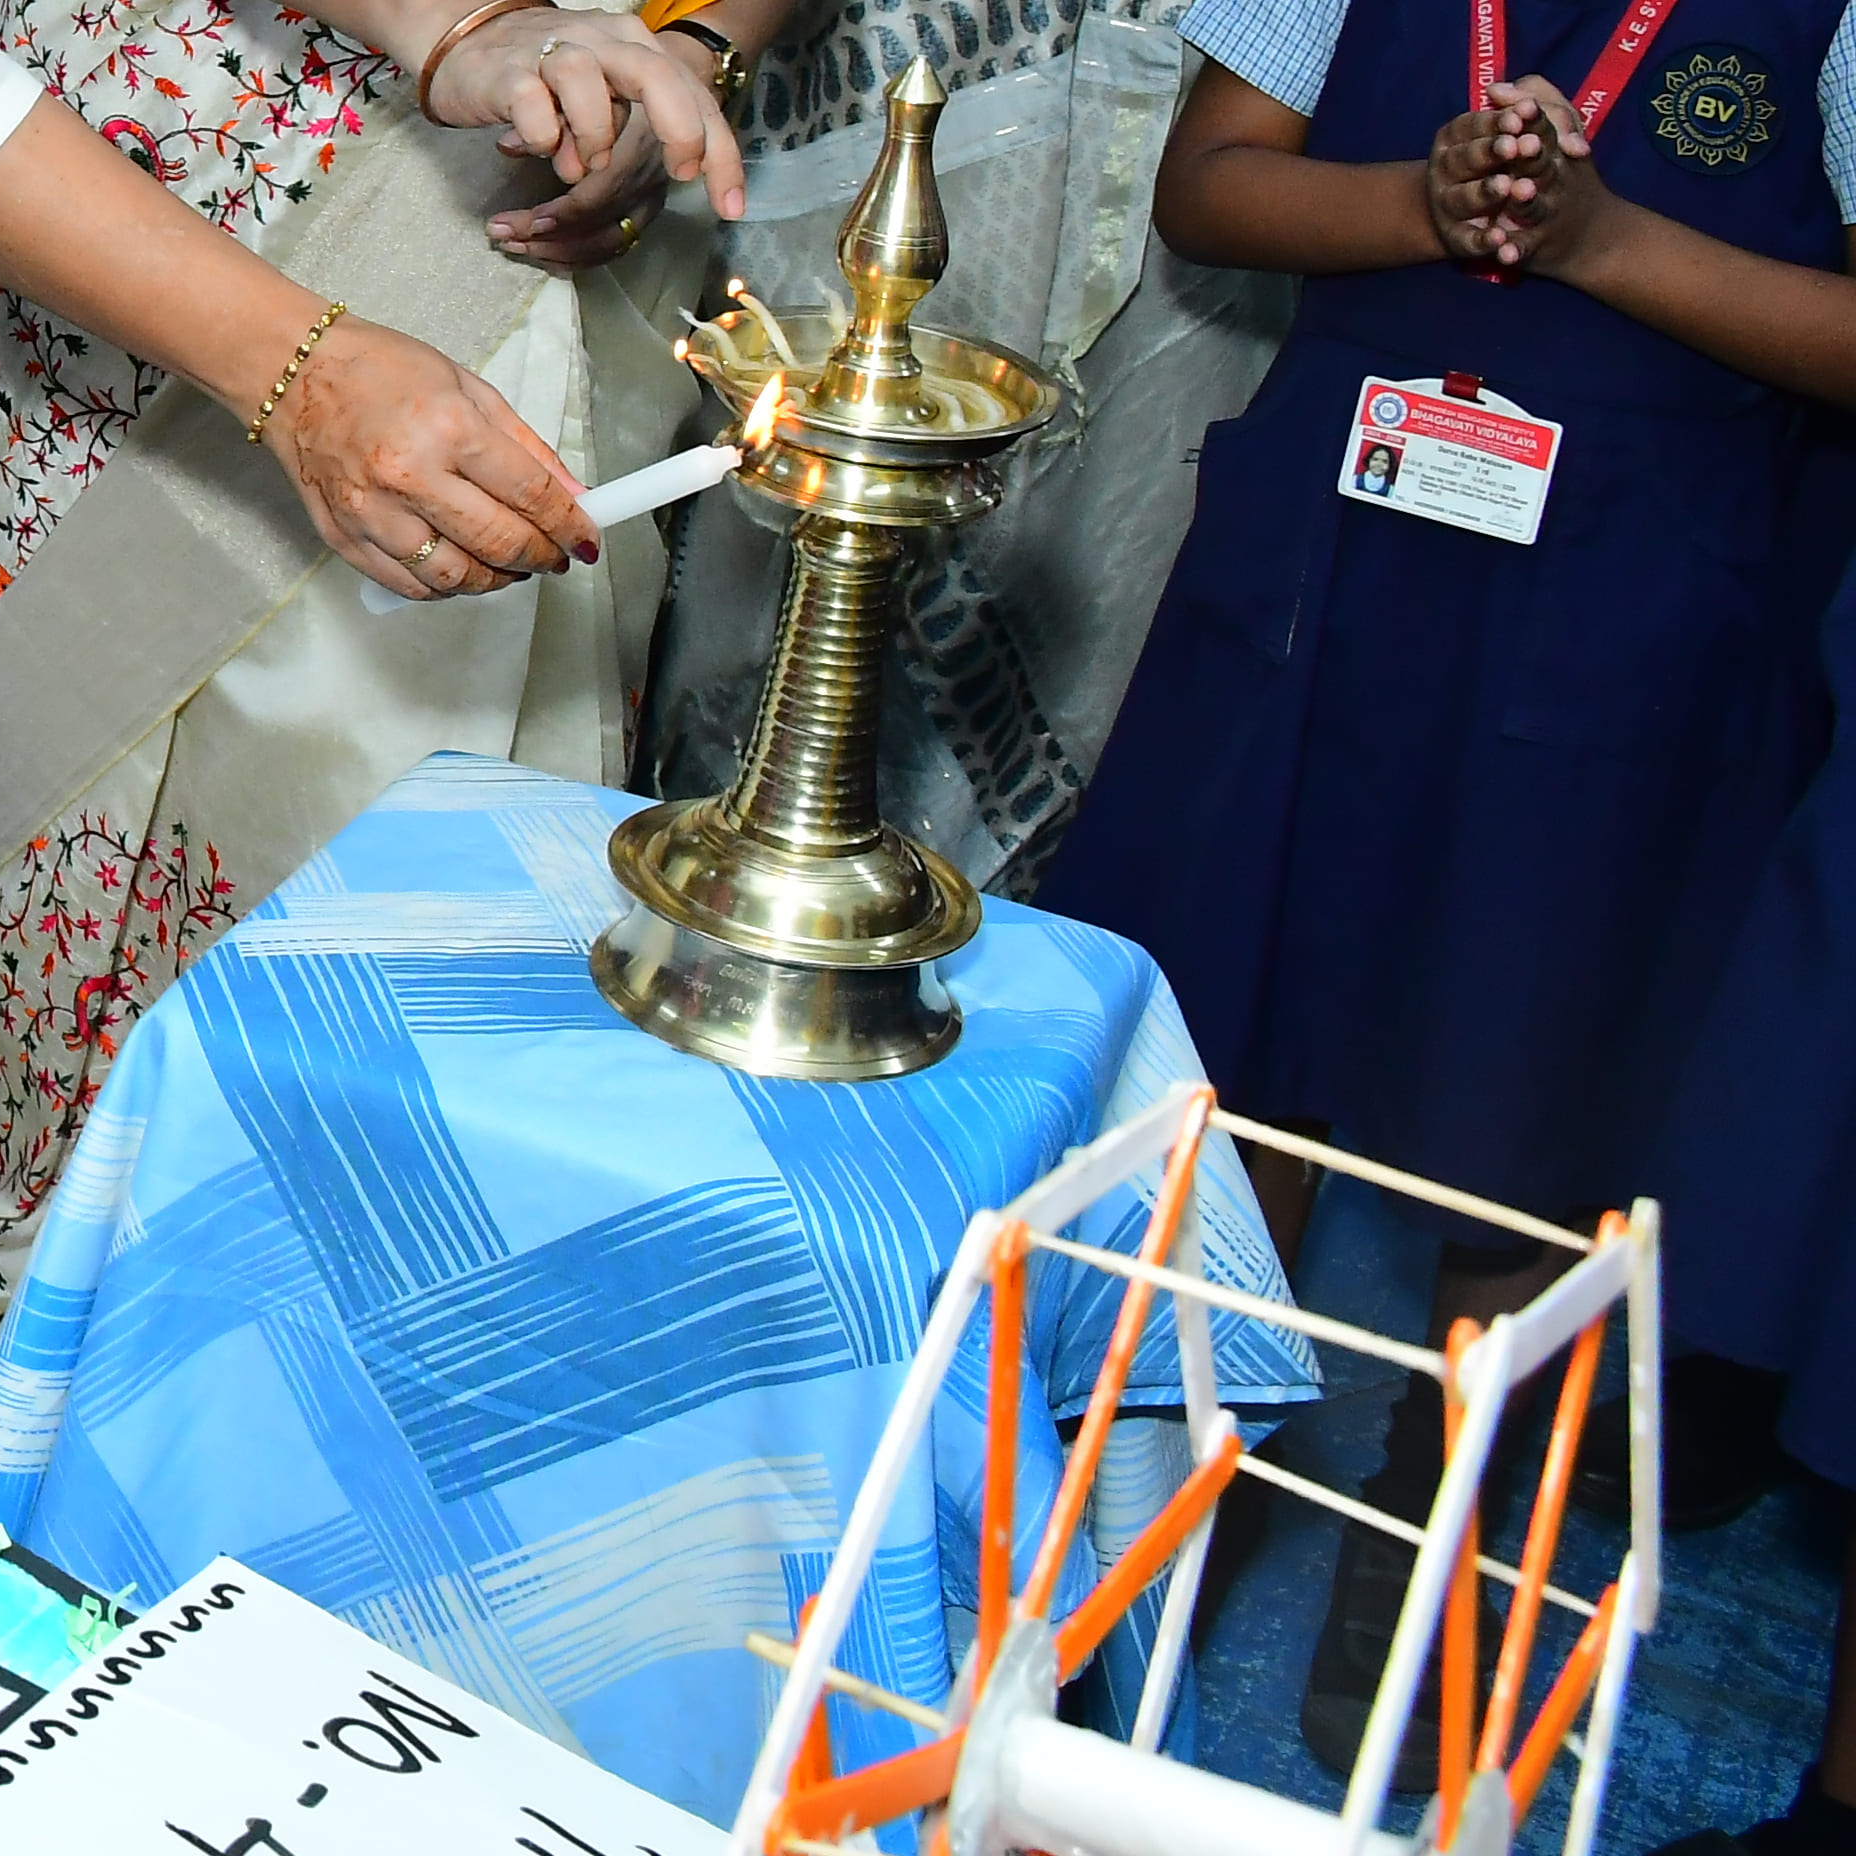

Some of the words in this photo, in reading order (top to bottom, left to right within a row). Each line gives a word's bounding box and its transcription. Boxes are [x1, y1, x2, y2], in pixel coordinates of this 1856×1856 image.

[1694, 95, 1737, 123] BV
[1410, 408, 1476, 435] BHAGAVATI
[1475, 425, 1539, 451] VIDYALAYA
